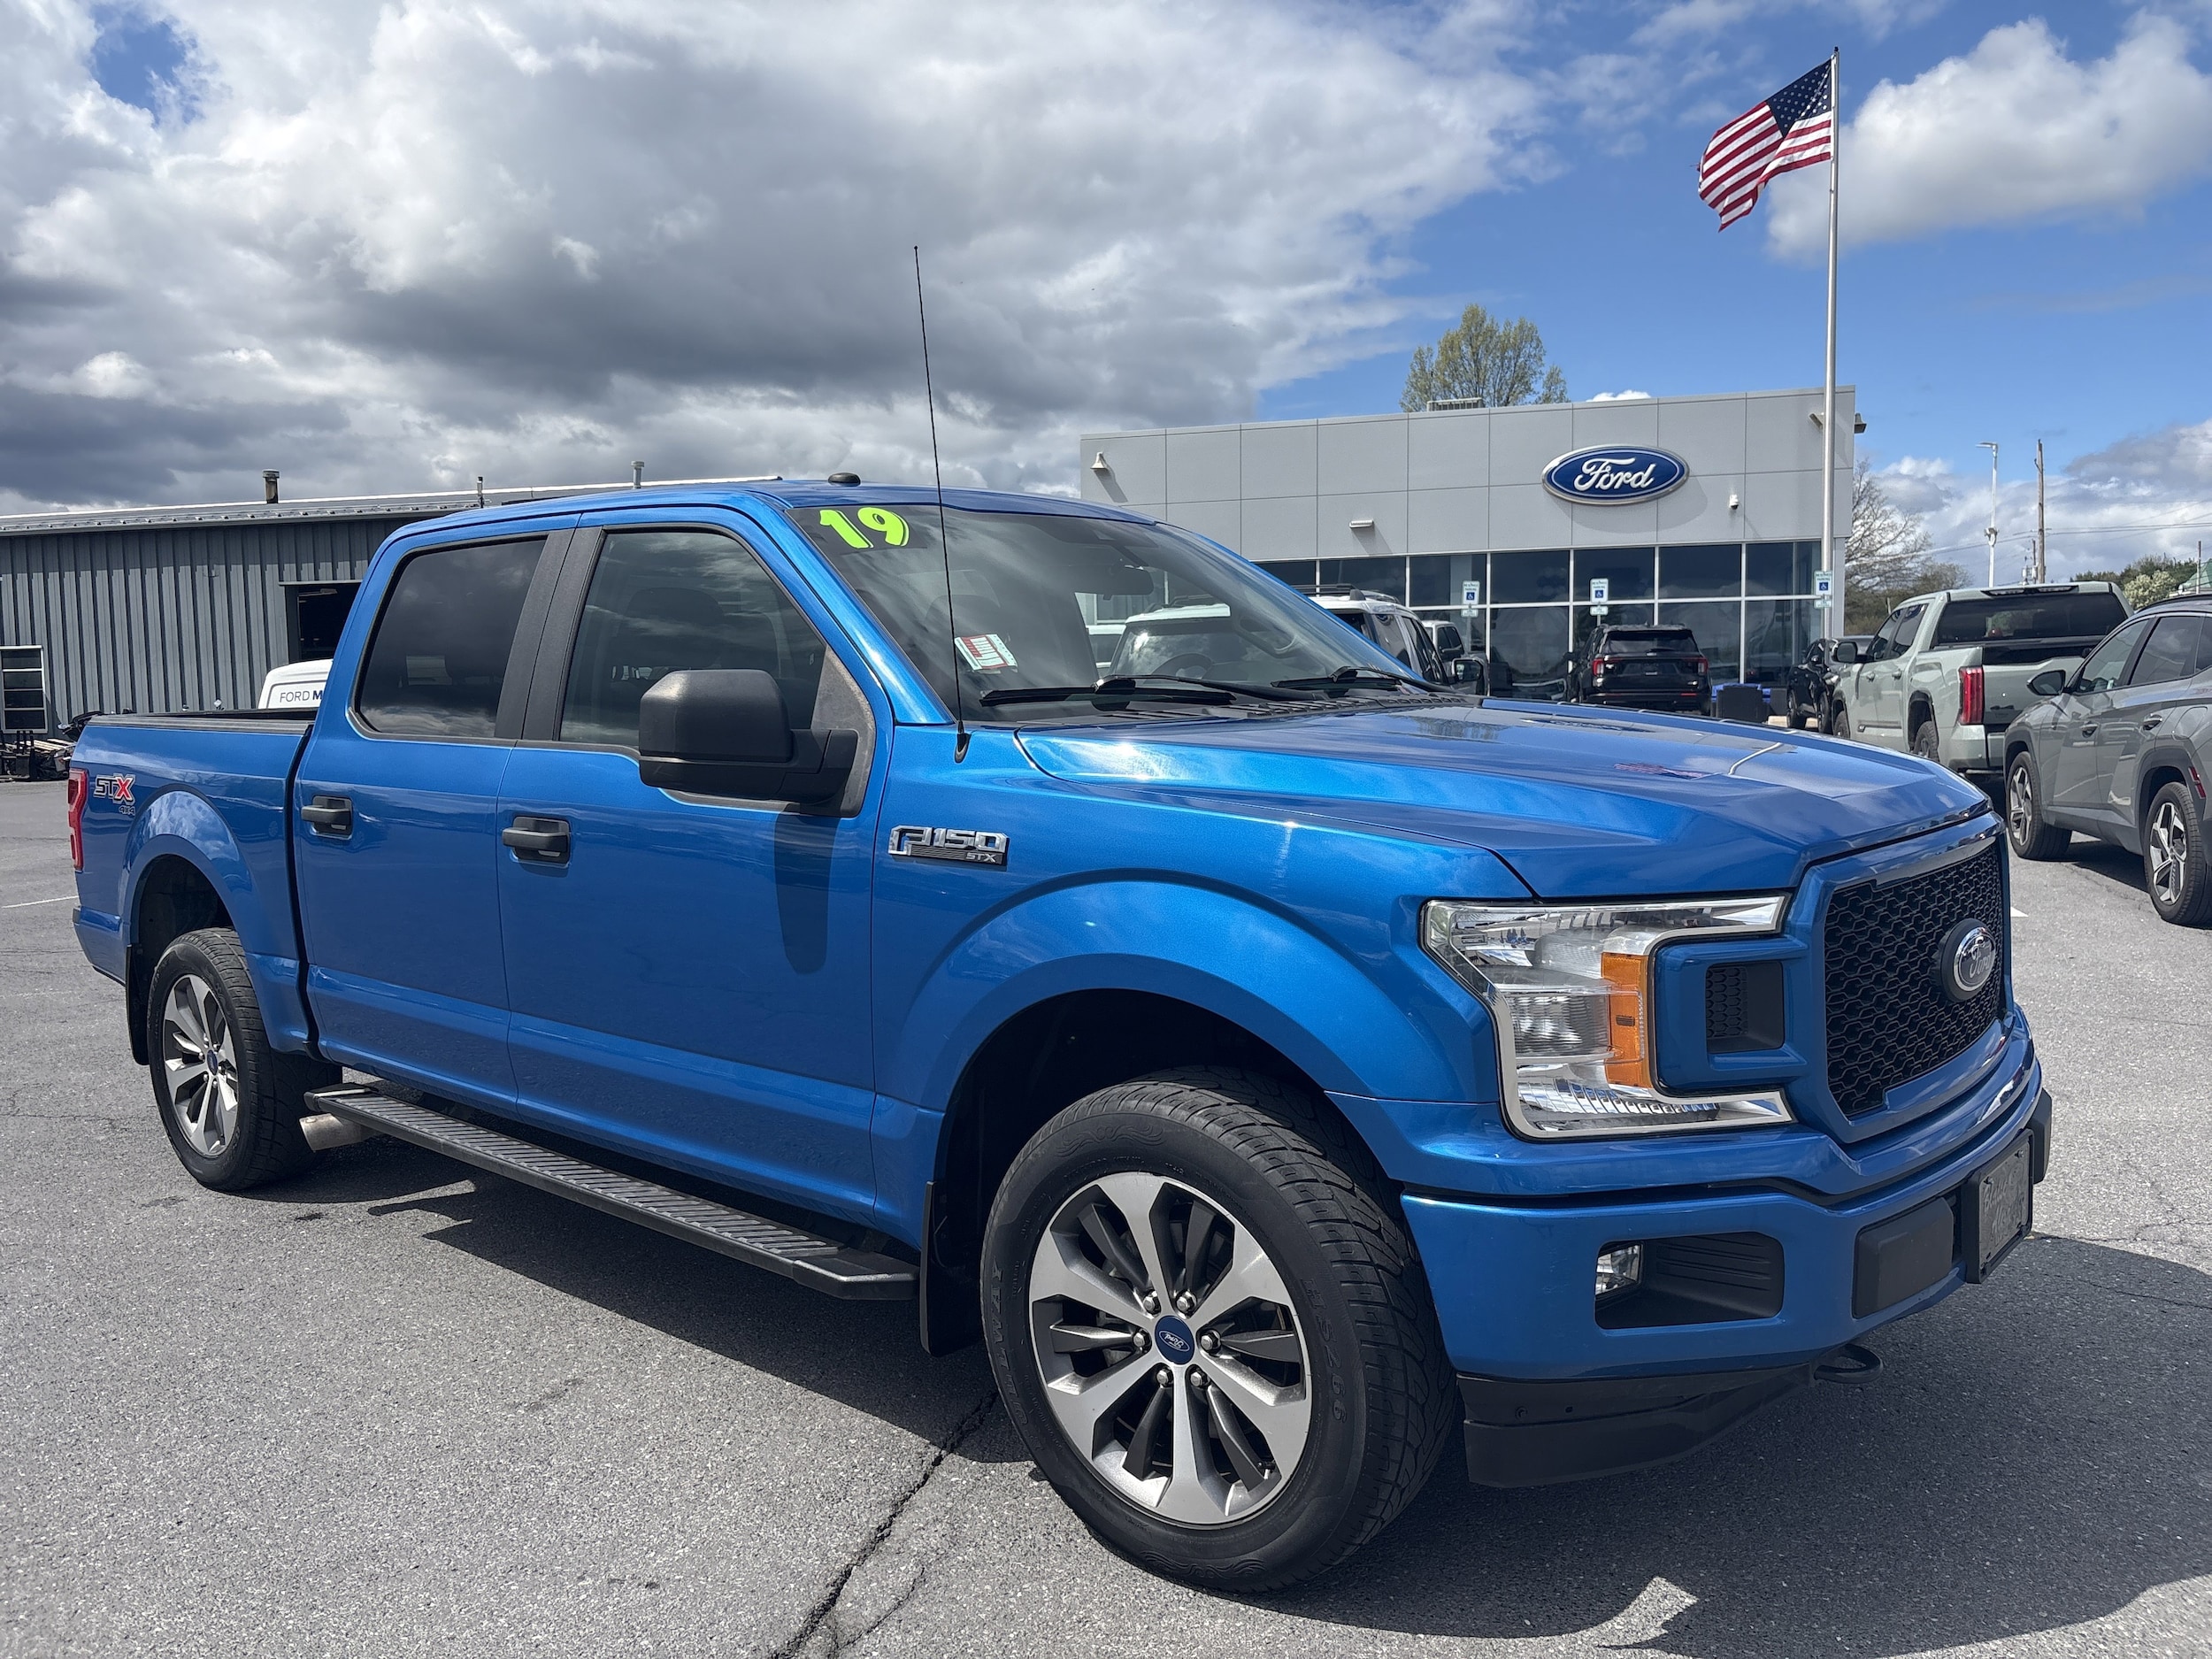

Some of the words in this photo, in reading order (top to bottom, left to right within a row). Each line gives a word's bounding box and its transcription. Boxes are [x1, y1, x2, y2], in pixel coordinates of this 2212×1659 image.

[1573, 457, 1656, 491] Ford
[819, 507, 910, 549] 19
[280, 691, 310, 703] FORD
[94, 774, 134, 803] STX
[965, 851, 996, 863] STX
[1164, 1333, 1185, 1350] Ford
[1300, 1279, 1348, 1424] HS266
